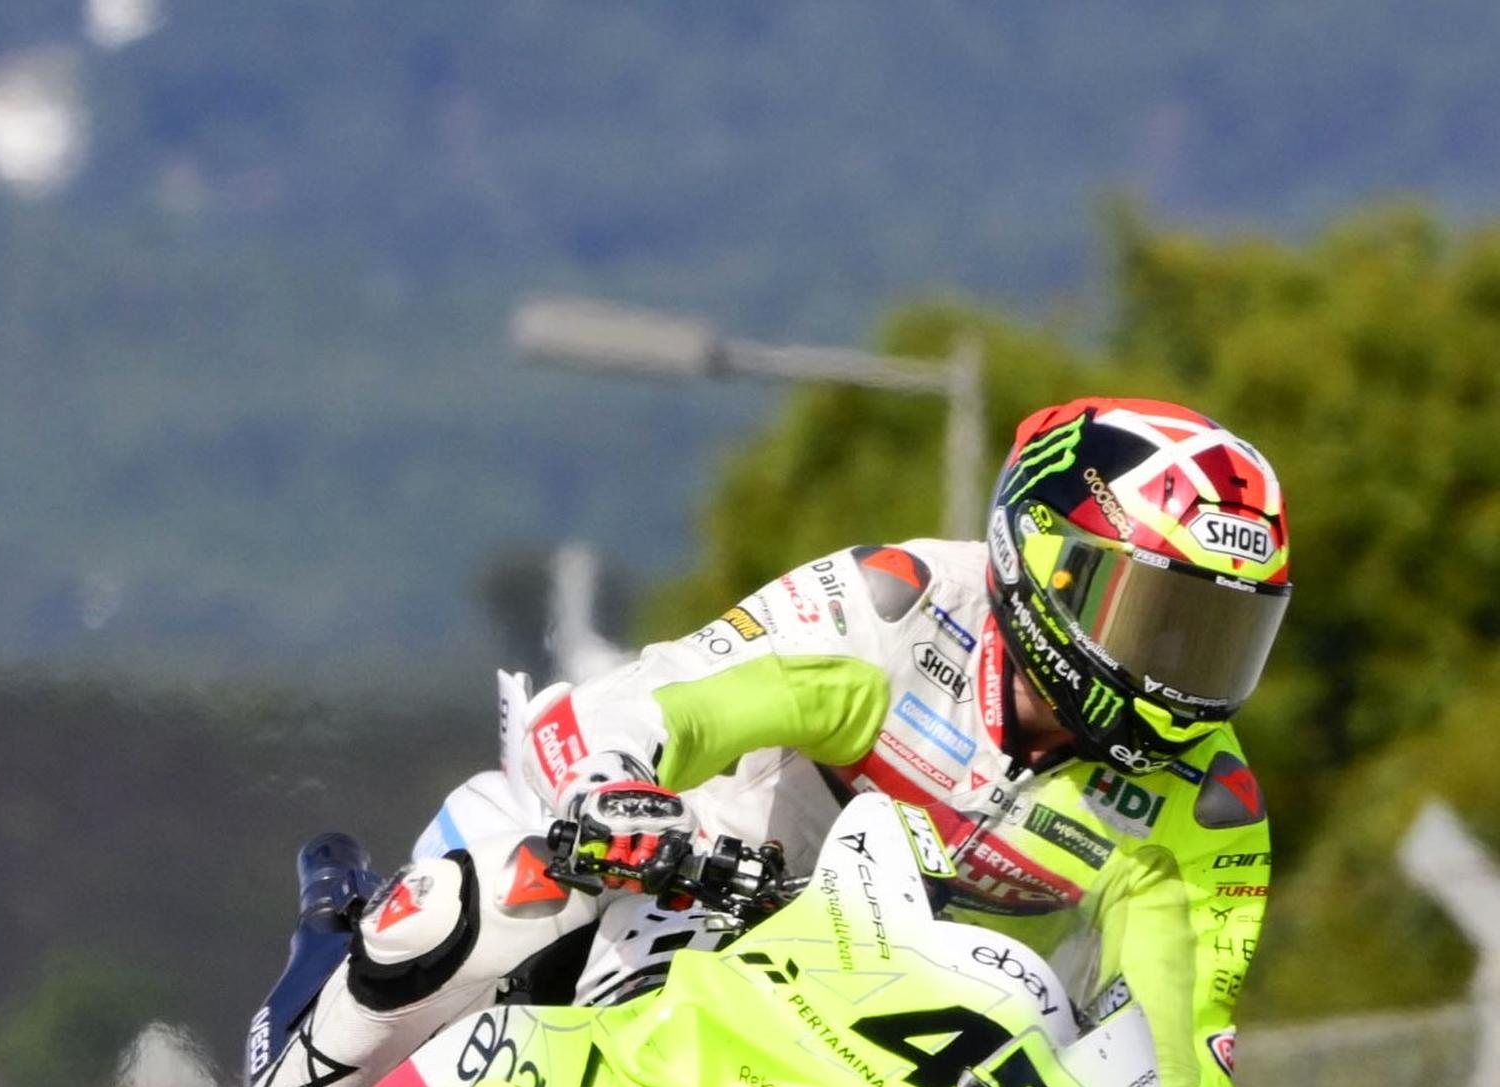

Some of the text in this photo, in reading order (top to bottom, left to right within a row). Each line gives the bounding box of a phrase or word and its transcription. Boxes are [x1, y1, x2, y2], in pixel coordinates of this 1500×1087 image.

[1206, 520, 1268, 556] SHOEI
[811, 559, 846, 599] Dair
[1010, 591, 1082, 691] MONSTER
[858, 863, 891, 961] CUPRA
[972, 946, 1059, 1016] ebay
[250, 1006, 270, 1075] IVECO
